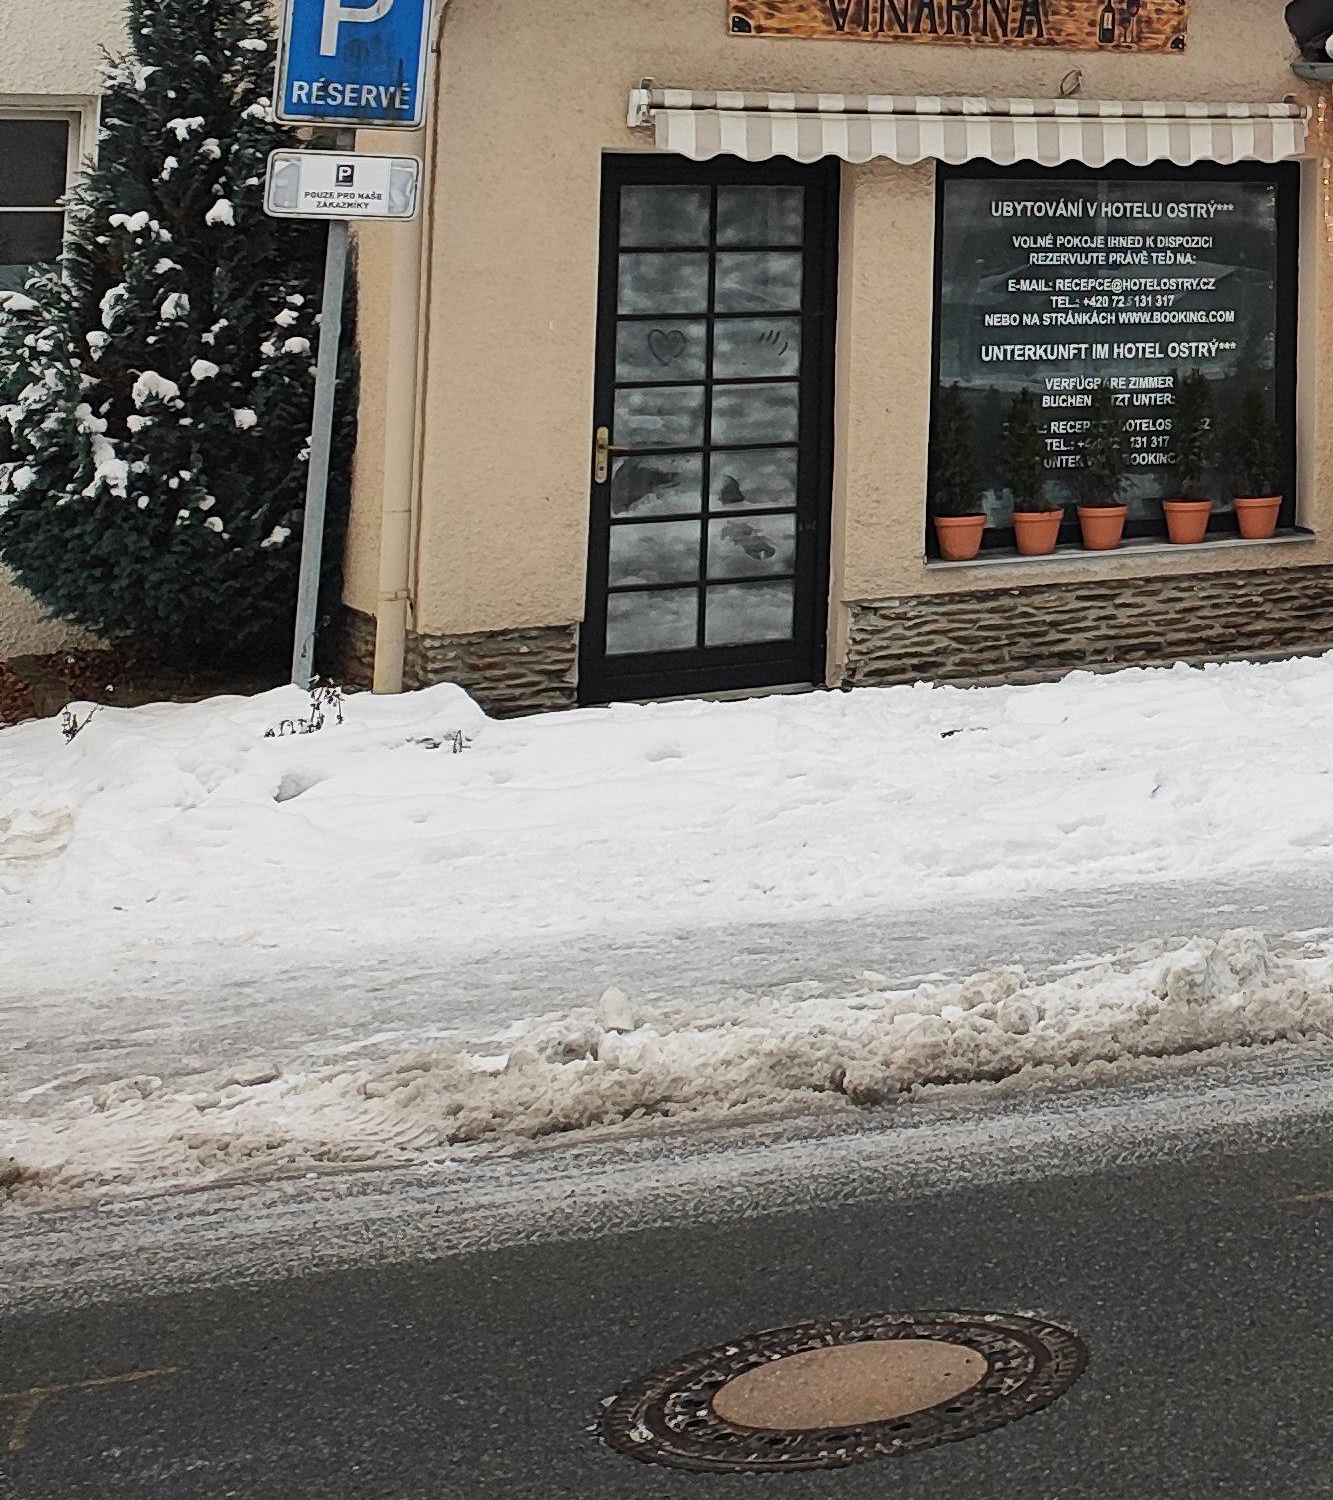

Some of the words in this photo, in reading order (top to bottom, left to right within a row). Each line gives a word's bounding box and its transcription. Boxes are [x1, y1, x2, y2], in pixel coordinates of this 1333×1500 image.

[291, 76, 411, 110] RÉSERVÉ
[304, 191, 334, 200] POUZE
[337, 192, 355, 200] PRO
[991, 199, 1084, 218] UBYTOVÁNÍ
[1087, 201, 1099, 218] V
[1101, 202, 1163, 218] HOTELU
[1012, 232, 1054, 248] VOLNÉ
[1056, 236, 1105, 248] POKOJE
[1107, 235, 1143, 248] IHNED
[1146, 235, 1155, 248] K
[1156, 235, 1213, 248] DISPOZICI
[1029, 253, 1107, 265] REZERVUJTE
[1109, 250, 1149, 265] PRÁVĚ
[1176, 252, 1197, 265] NA:
[1007, 279, 1053, 292] E-MAIL:
[1055, 277, 1216, 293] RECEPCE@HOTELOSTRY.CZ
[1050, 296, 1080, 309] TEL.:
[1083, 295, 1109, 308] +420
[1134, 295, 1152, 308] 131
[1155, 294, 1175, 307] 317
[985, 313, 1020, 327] NEBO
[1022, 313, 1041, 326] NA
[1042, 309, 1116, 326] STRÁNKÁCH
[1118, 310, 1235, 325] WWW.BOOKING.COM
[981, 343, 1089, 361] UNTERKUNFT
[1092, 343, 1109, 360] IM
[1113, 342, 1165, 359] HOTEL
[1128, 375, 1174, 389] ZIMMER
[1042, 394, 1092, 407] BUCHEN
[1133, 393, 1176, 406] UNTER:
[1045, 438, 1075, 452] TEL.:
[1130, 436, 1148, 449] 131
[1150, 435, 1171, 449] 317
